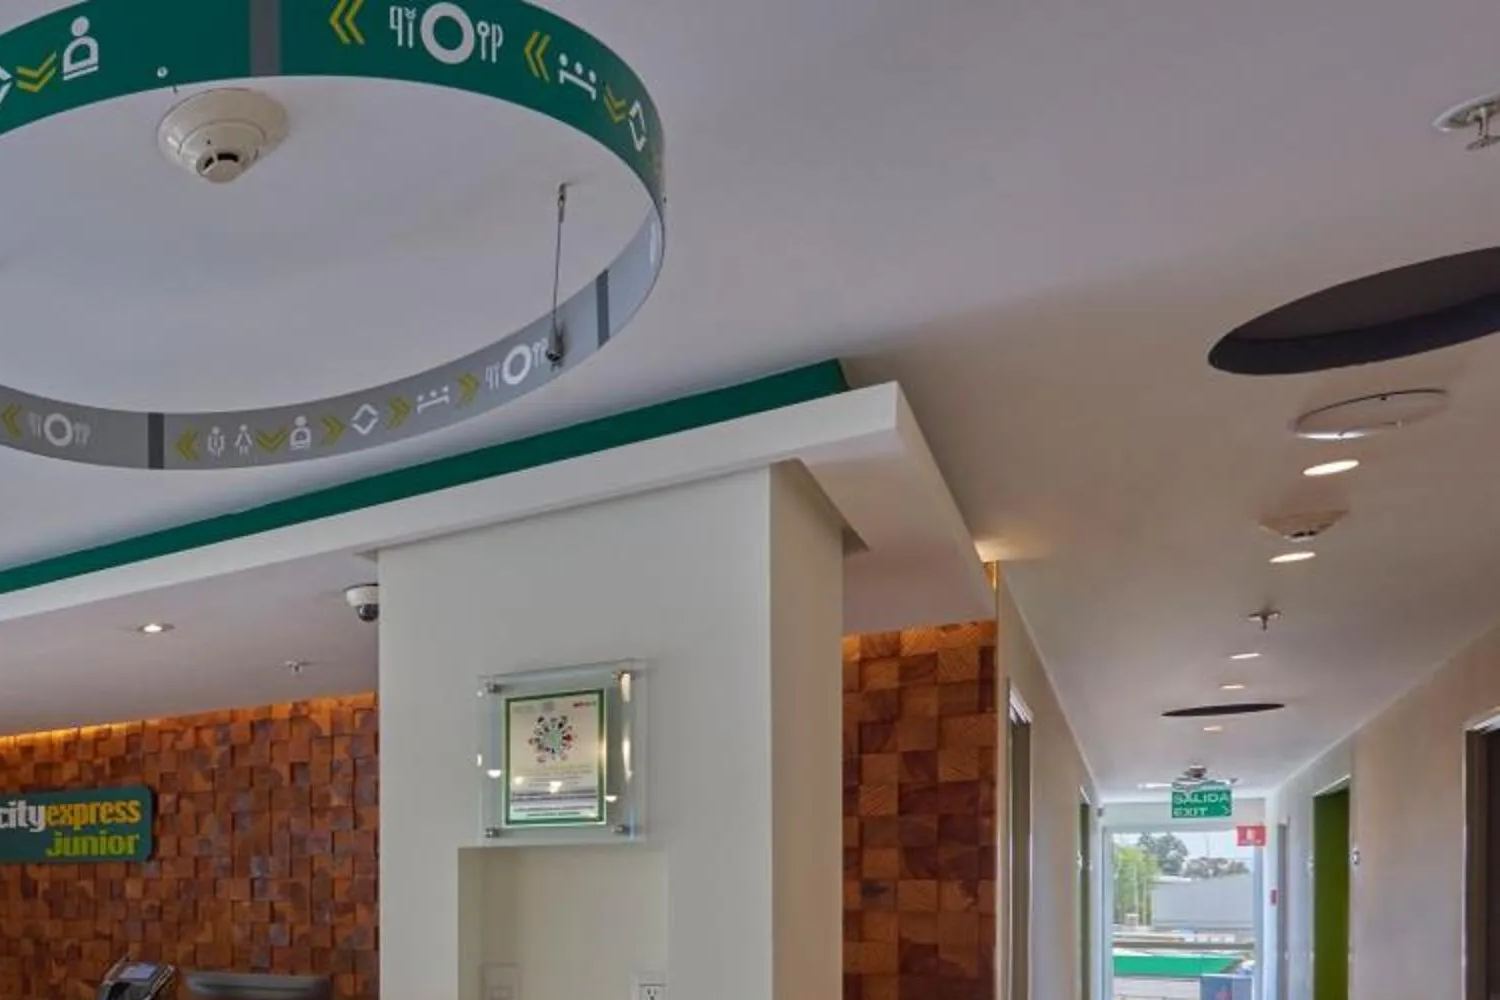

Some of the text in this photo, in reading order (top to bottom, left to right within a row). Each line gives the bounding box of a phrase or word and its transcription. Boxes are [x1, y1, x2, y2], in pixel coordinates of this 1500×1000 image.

[1173, 791, 1229, 804] SALIDA
[1173, 807, 1208, 817] EXIT
[46, 830, 140, 857] junior
